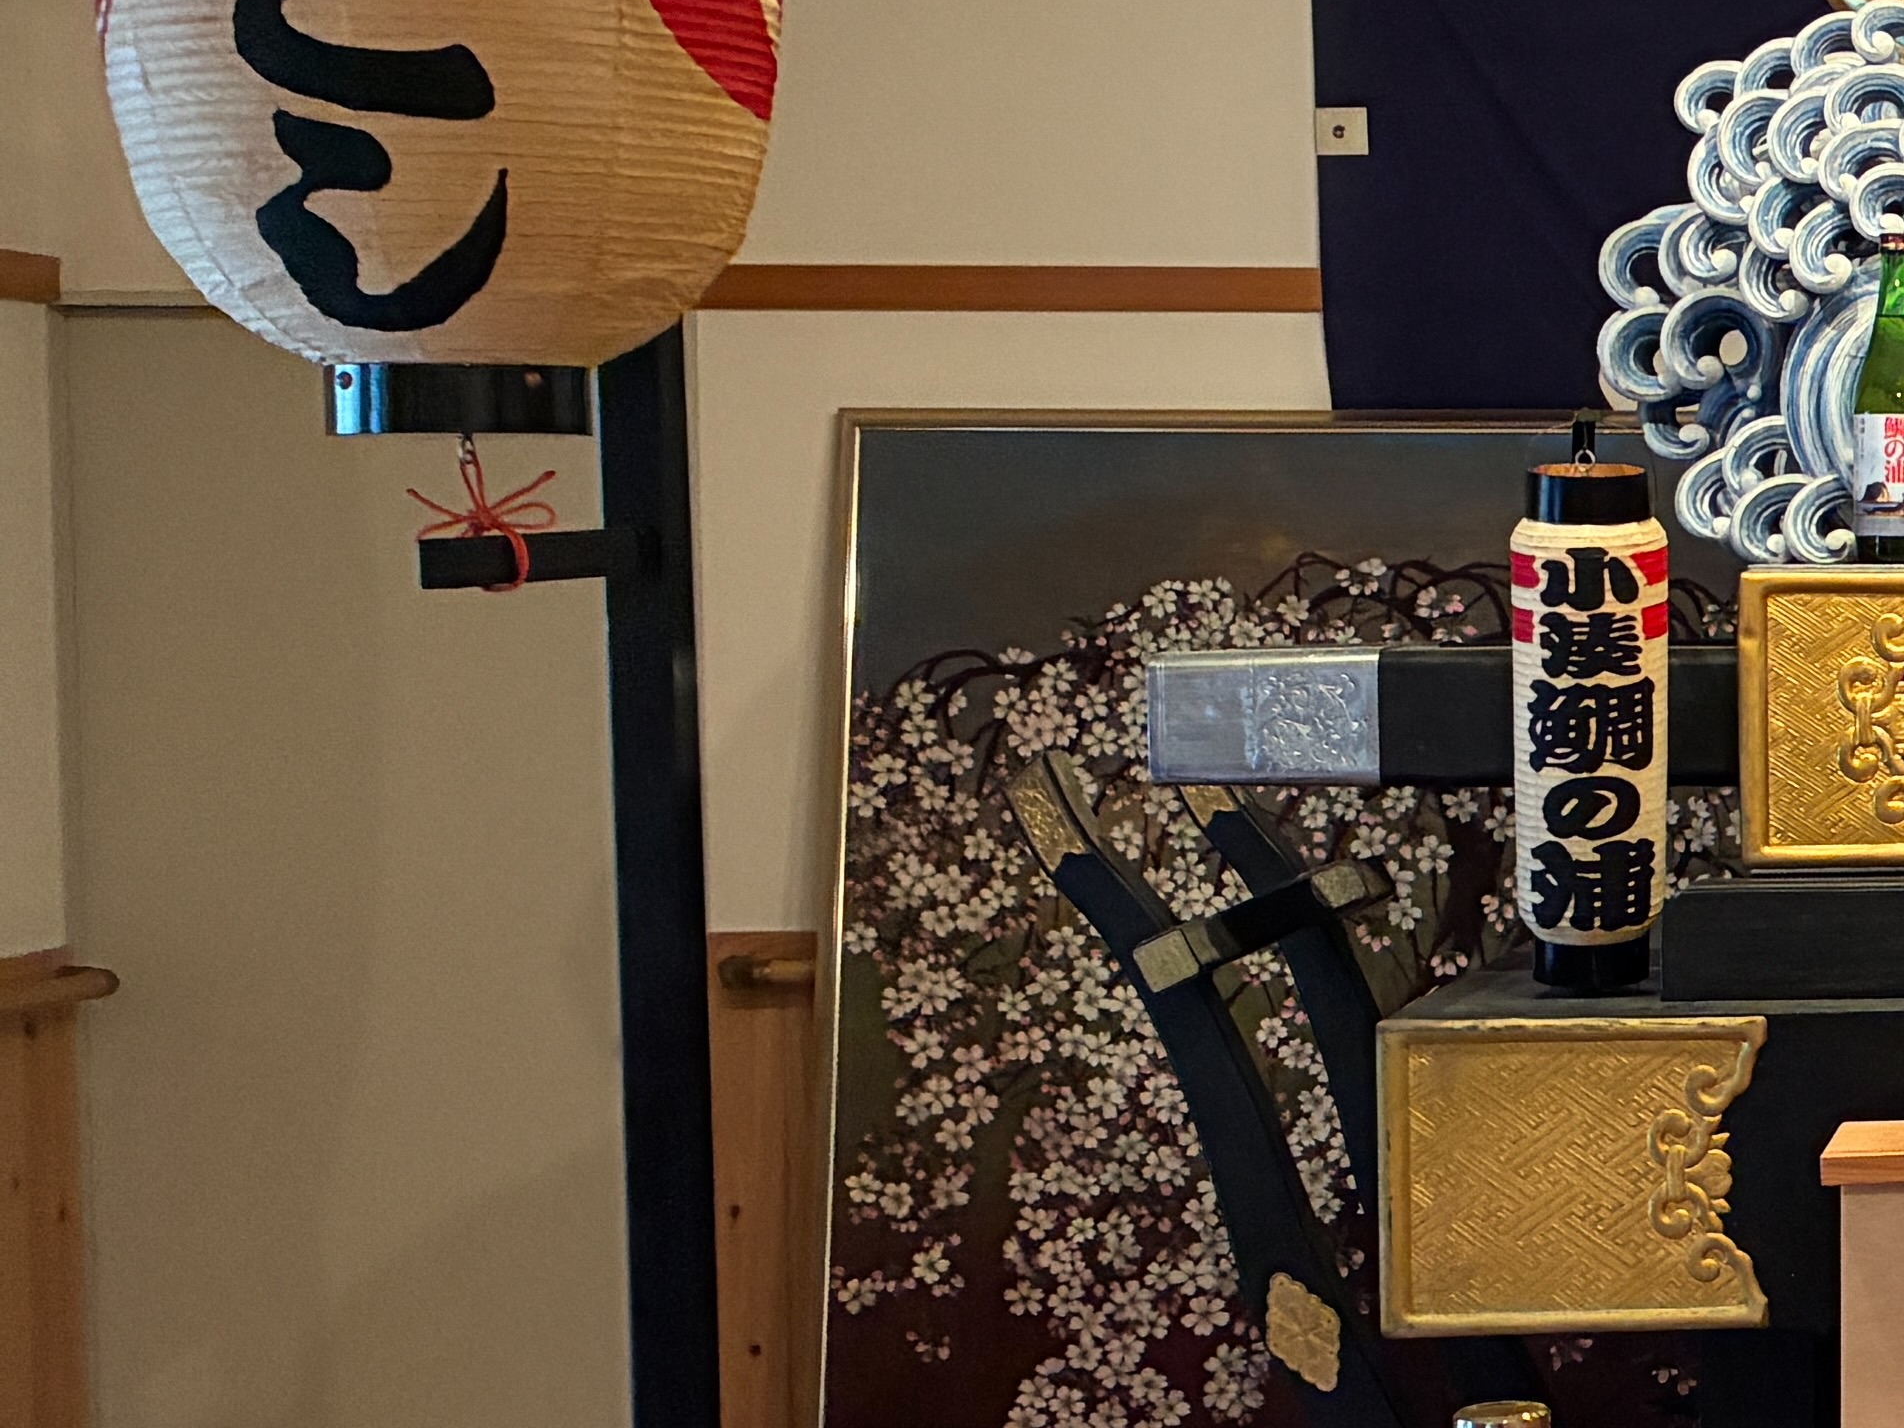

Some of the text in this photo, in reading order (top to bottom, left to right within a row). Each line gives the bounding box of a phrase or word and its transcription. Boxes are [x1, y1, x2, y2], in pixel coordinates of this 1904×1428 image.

[1528, 547, 1655, 931] 小湊鯛の浦
